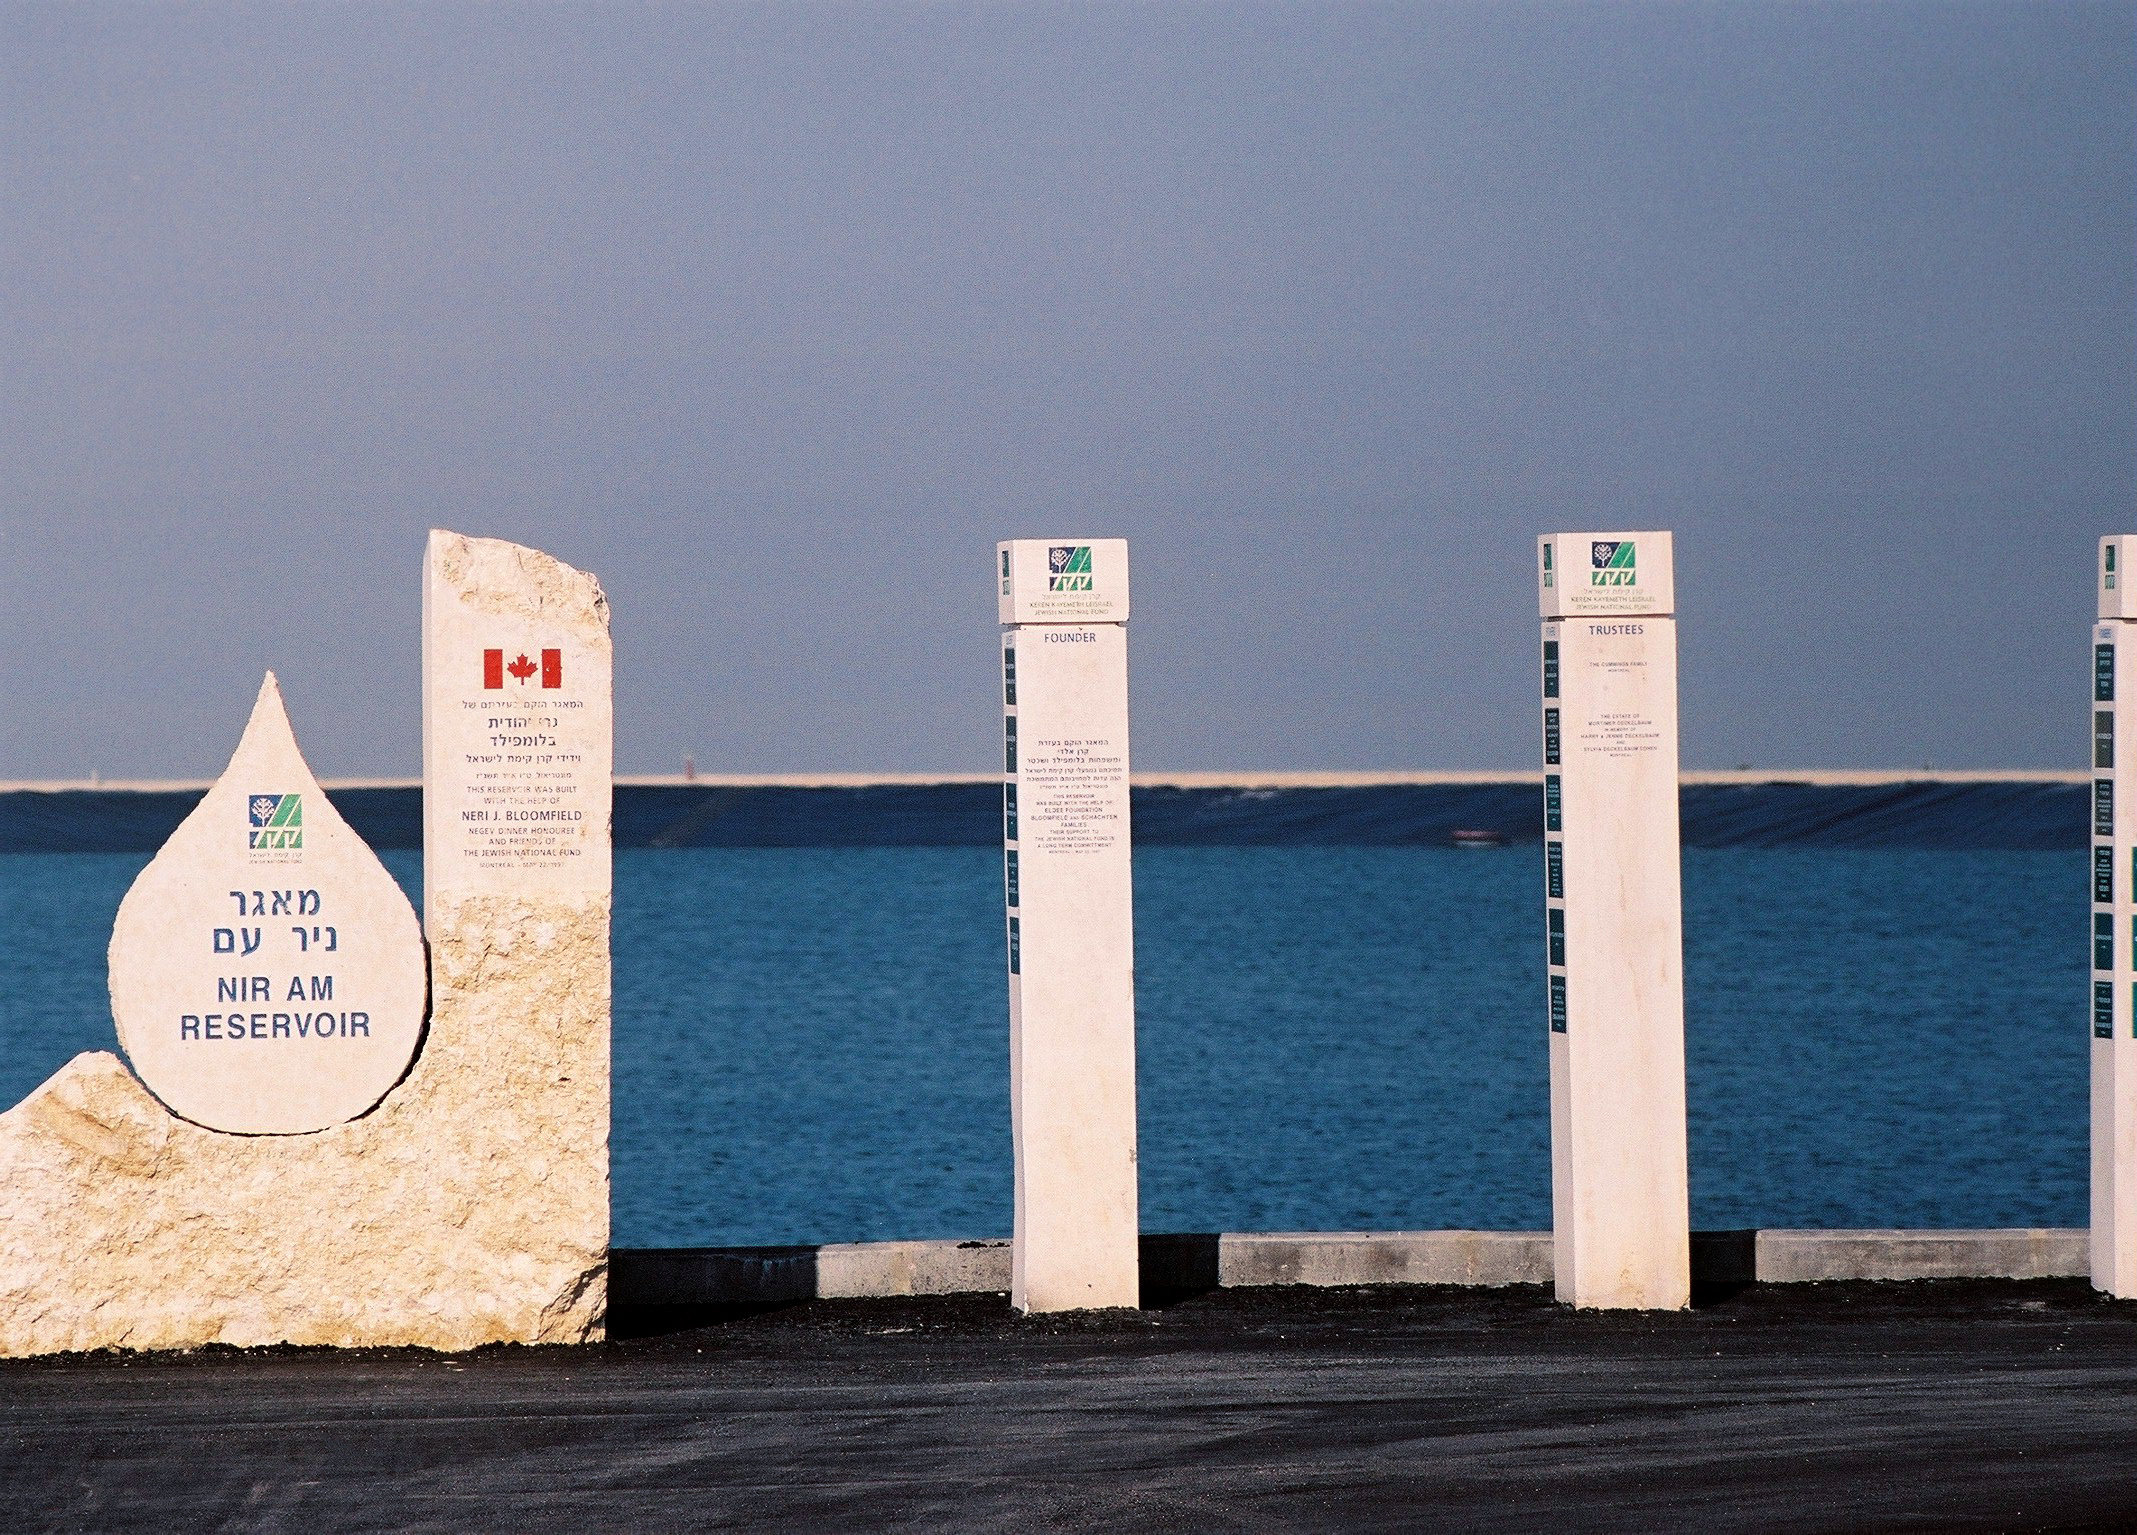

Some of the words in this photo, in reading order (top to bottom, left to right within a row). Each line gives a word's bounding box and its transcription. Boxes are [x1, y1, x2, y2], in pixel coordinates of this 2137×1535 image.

[1589, 625, 1644, 635] TRUSTEES
[1044, 632, 1096, 643] FOUNDER
[462, 700, 477, 709] של
[490, 733, 557, 747] בלומפילד
[465, 754, 502, 763] לישראל
[507, 755, 532, 764] קימת
[536, 755, 553, 765] קרן
[467, 785, 485, 794] THIS
[487, 785, 531, 794] RESERVOIR
[534, 785, 553, 794] WAS
[555, 785, 578, 794] BUILT
[461, 810, 489, 821] NERI
[493, 810, 501, 821] J.
[506, 810, 582, 821] BLOOMFIELD
[468, 827, 495, 835] NEGEV
[498, 827, 528, 835] DINNER
[531, 827, 575, 835] HONOUREE
[463, 849, 478, 857] THE
[481, 849, 511, 857] JEWISH
[514, 849, 557, 857] NATIONAL
[559, 849, 581, 857] FUND
[229, 889, 321, 917] מאגר
[213, 927, 262, 957] עם
[291, 926, 337, 952] ניר
[217, 976, 271, 1003] NIR
[286, 975, 333, 1001] AM
[181, 1012, 371, 1041] RESERVOIR
